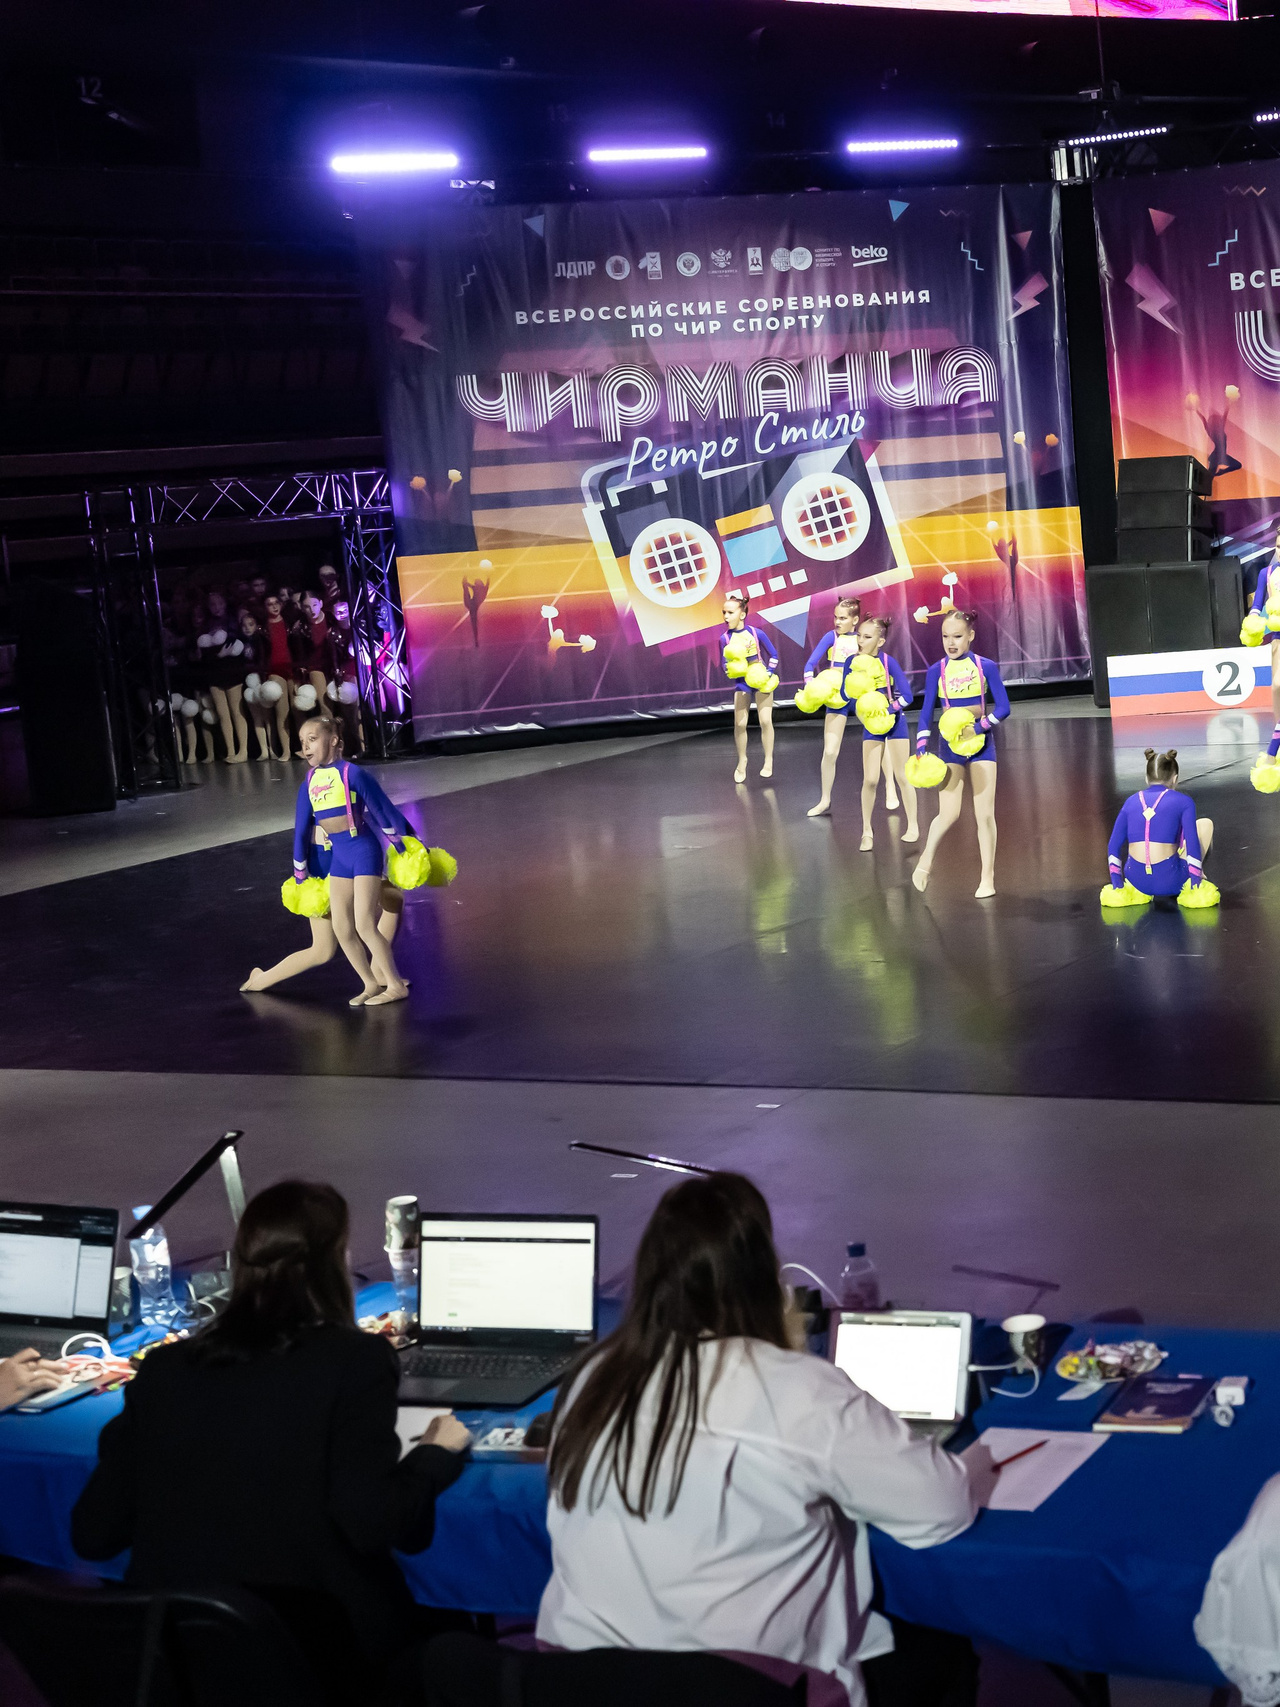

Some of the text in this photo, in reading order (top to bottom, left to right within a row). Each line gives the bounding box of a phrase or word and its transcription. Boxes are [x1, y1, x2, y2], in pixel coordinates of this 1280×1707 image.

[76, 76, 103, 97] 12
[851, 245, 888, 259] beko
[555, 260, 596, 279] ЛДПР
[515, 289, 931, 325] ВСЕРОССИЙСКИЕ СОРЕВНОВАНИЯ
[631, 313, 825, 338] ПО ЧИР СПОРТУ
[626, 408, 865, 481] Ретро Стиль
[1215, 661, 1242, 697] 2
